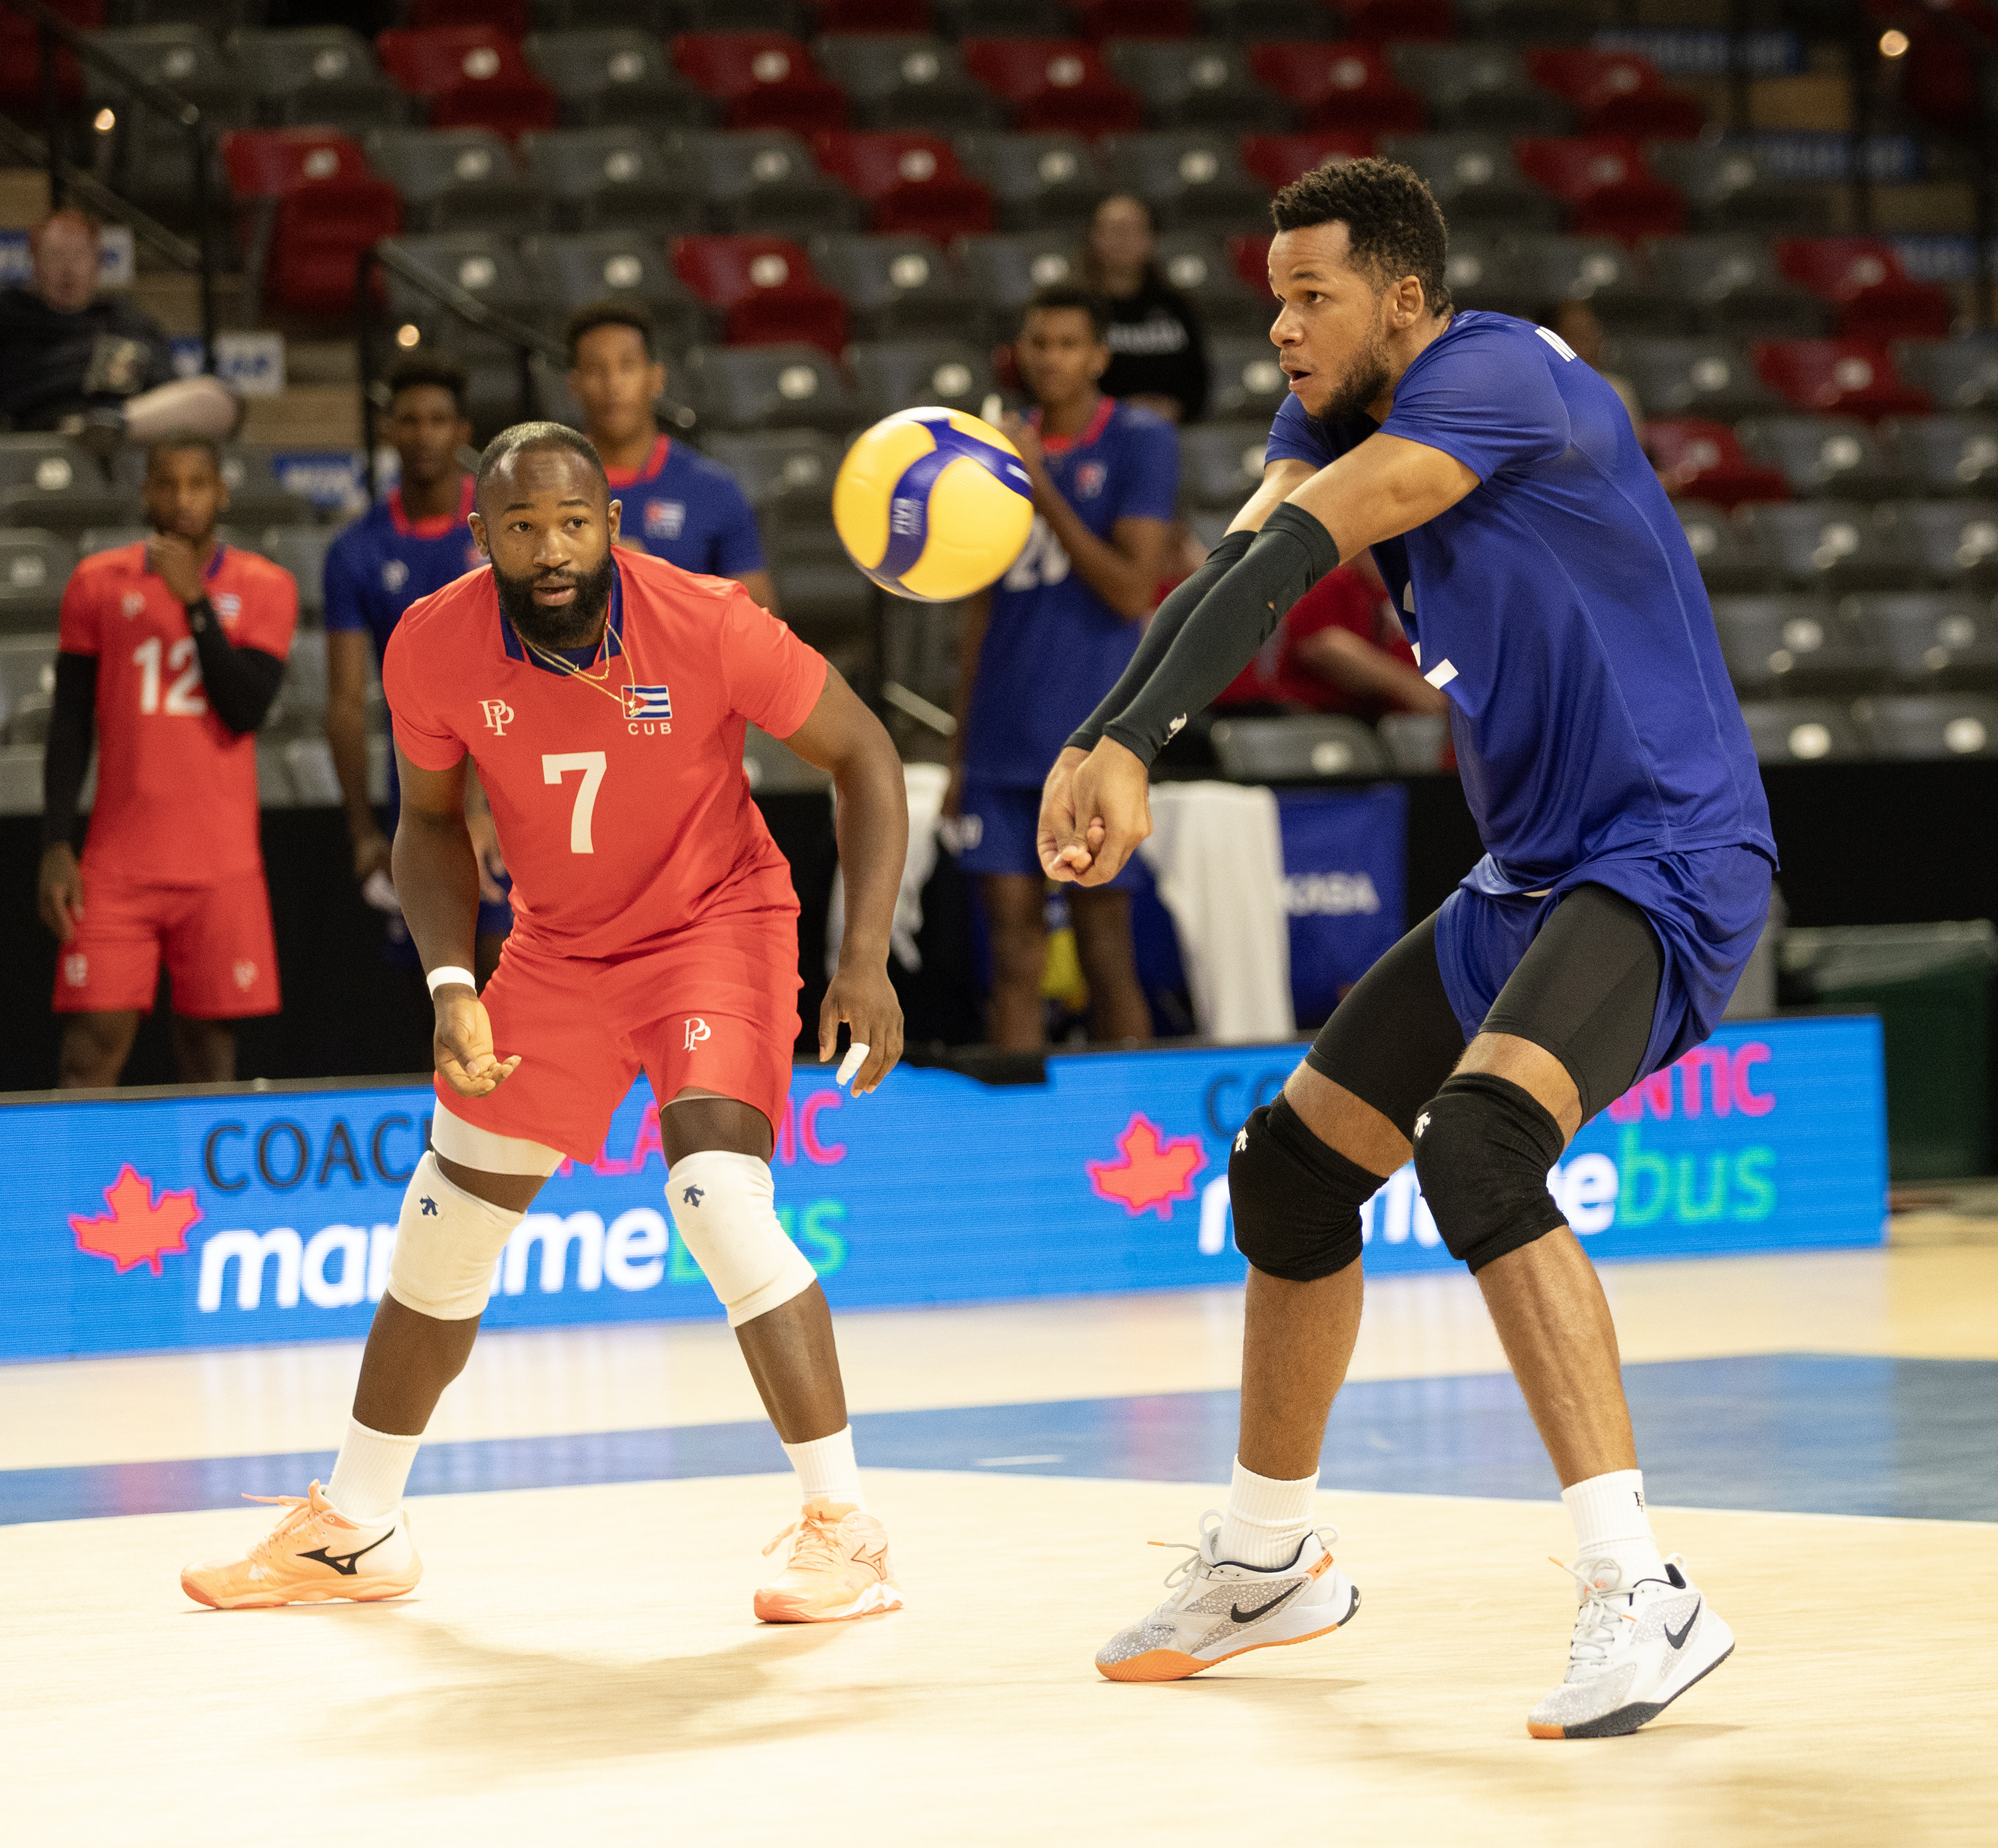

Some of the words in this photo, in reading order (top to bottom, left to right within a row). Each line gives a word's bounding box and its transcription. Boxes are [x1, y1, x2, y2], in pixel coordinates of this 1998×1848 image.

[133, 635, 208, 717] 12
[627, 722, 672, 735] CUB
[541, 751, 607, 854] 7
